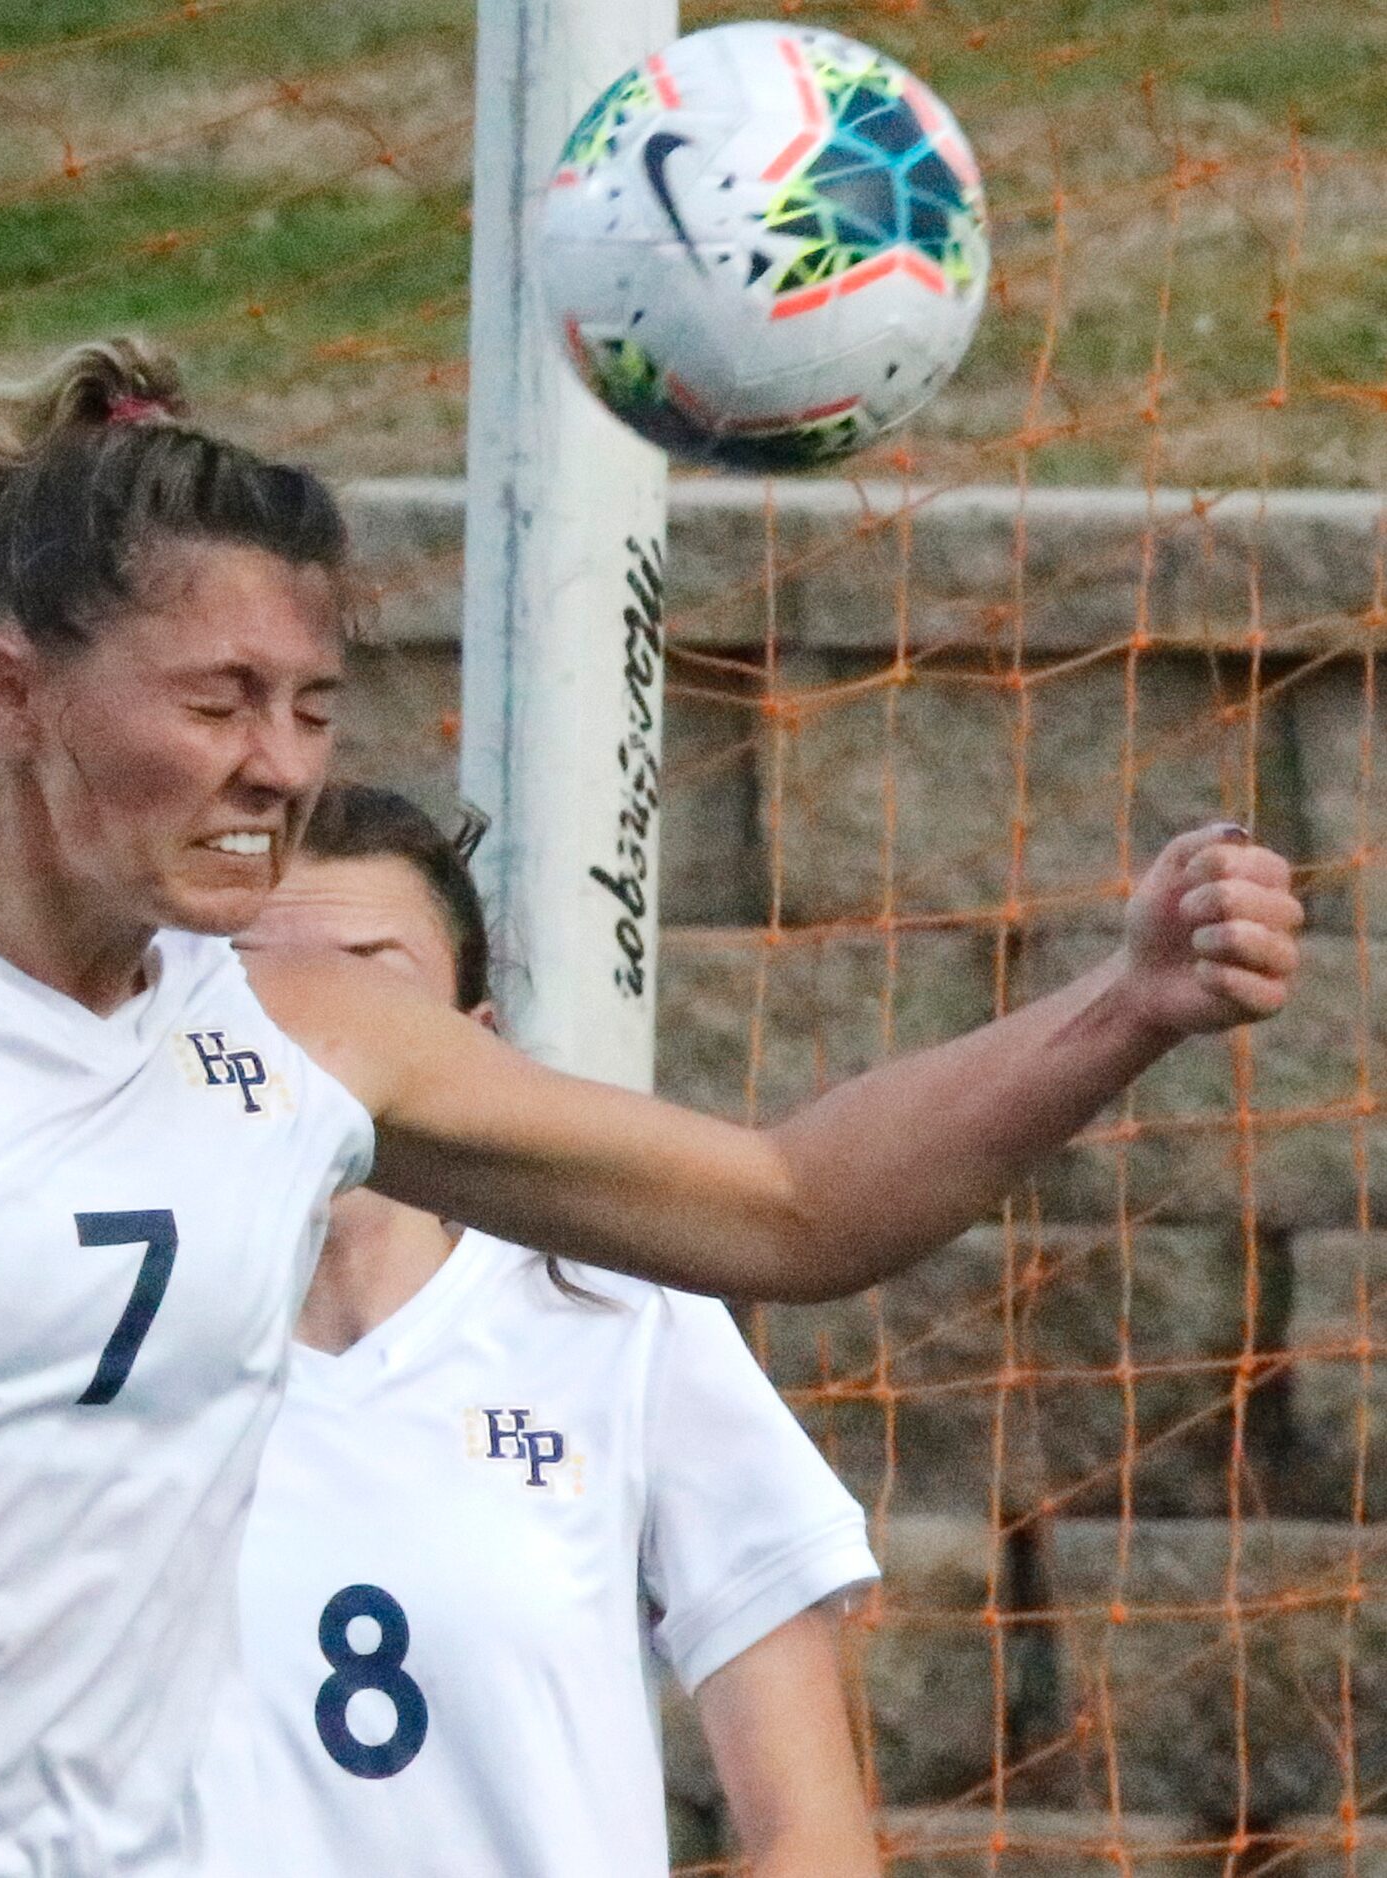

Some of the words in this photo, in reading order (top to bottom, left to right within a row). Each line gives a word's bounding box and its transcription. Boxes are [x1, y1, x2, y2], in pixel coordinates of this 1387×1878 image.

[185, 1031, 267, 1113] HP
[74, 1209, 178, 1405] 7
[482, 1409, 564, 1486] HP
[315, 1583, 428, 1780] 8
